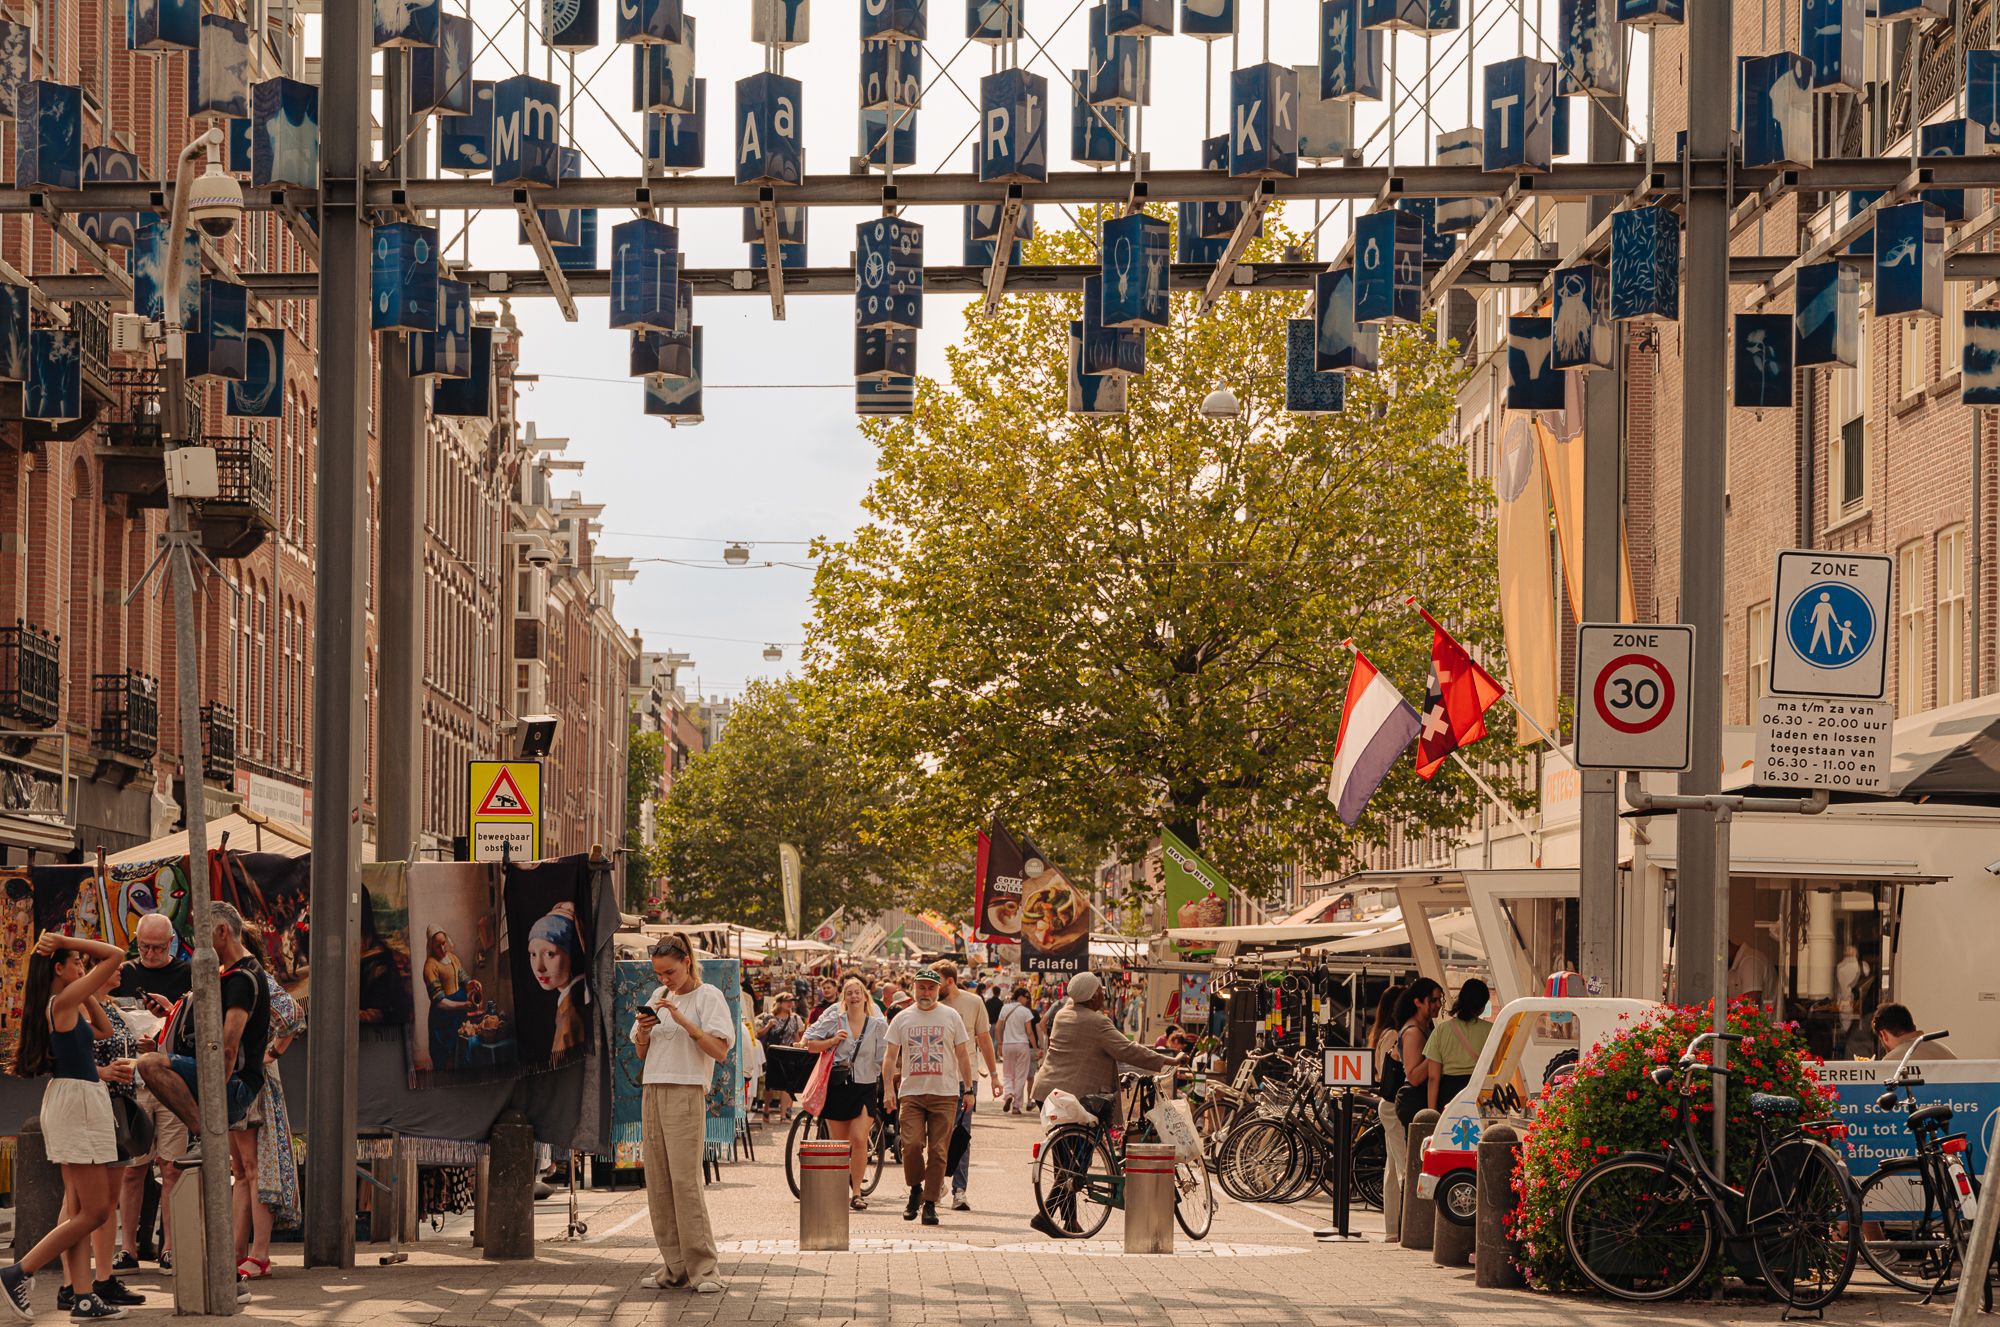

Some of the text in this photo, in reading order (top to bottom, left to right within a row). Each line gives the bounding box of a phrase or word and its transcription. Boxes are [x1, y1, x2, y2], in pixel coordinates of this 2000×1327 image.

[1275, 76, 1291, 130] k
[1534, 72, 1544, 124] t
[524, 96, 558, 144] m
[775, 97, 794, 139] a
[1025, 92, 1038, 132] r
[1492, 95, 1518, 149] T
[496, 111, 519, 165] M
[741, 112, 761, 163] A
[987, 107, 1009, 160] R
[1237, 100, 1259, 155] K
[1811, 561, 1858, 577] ZONE
[1613, 634, 1659, 647] ZONE
[1610, 678, 1658, 709] 30
[1777, 702, 1874, 715] ma t/m za van
[1763, 715, 1802, 726] 06.30
[1818, 718, 1858, 728] 20.00
[1864, 721, 1887, 730] uur
[1771, 729, 1876, 744] laden en lossen
[1771, 743, 1874, 758] toegestaan van
[1768, 757, 1807, 768] 06.30
[1823, 761, 1855, 770] 11.00
[1860, 764, 1875, 772] en
[1763, 771, 1798, 781] 16.30
[1814, 774, 1850, 784] 21.00
[1856, 778, 1879, 786] uur
[478, 833, 530, 841] beweegbaar
[1168, 848, 1213, 888] HOT BITE
[1029, 958, 1078, 969] Falafel
[1333, 1055, 1362, 1080] IN
[1873, 1123, 1897, 1135] tot
[1848, 1147, 1908, 1158] afbouw
